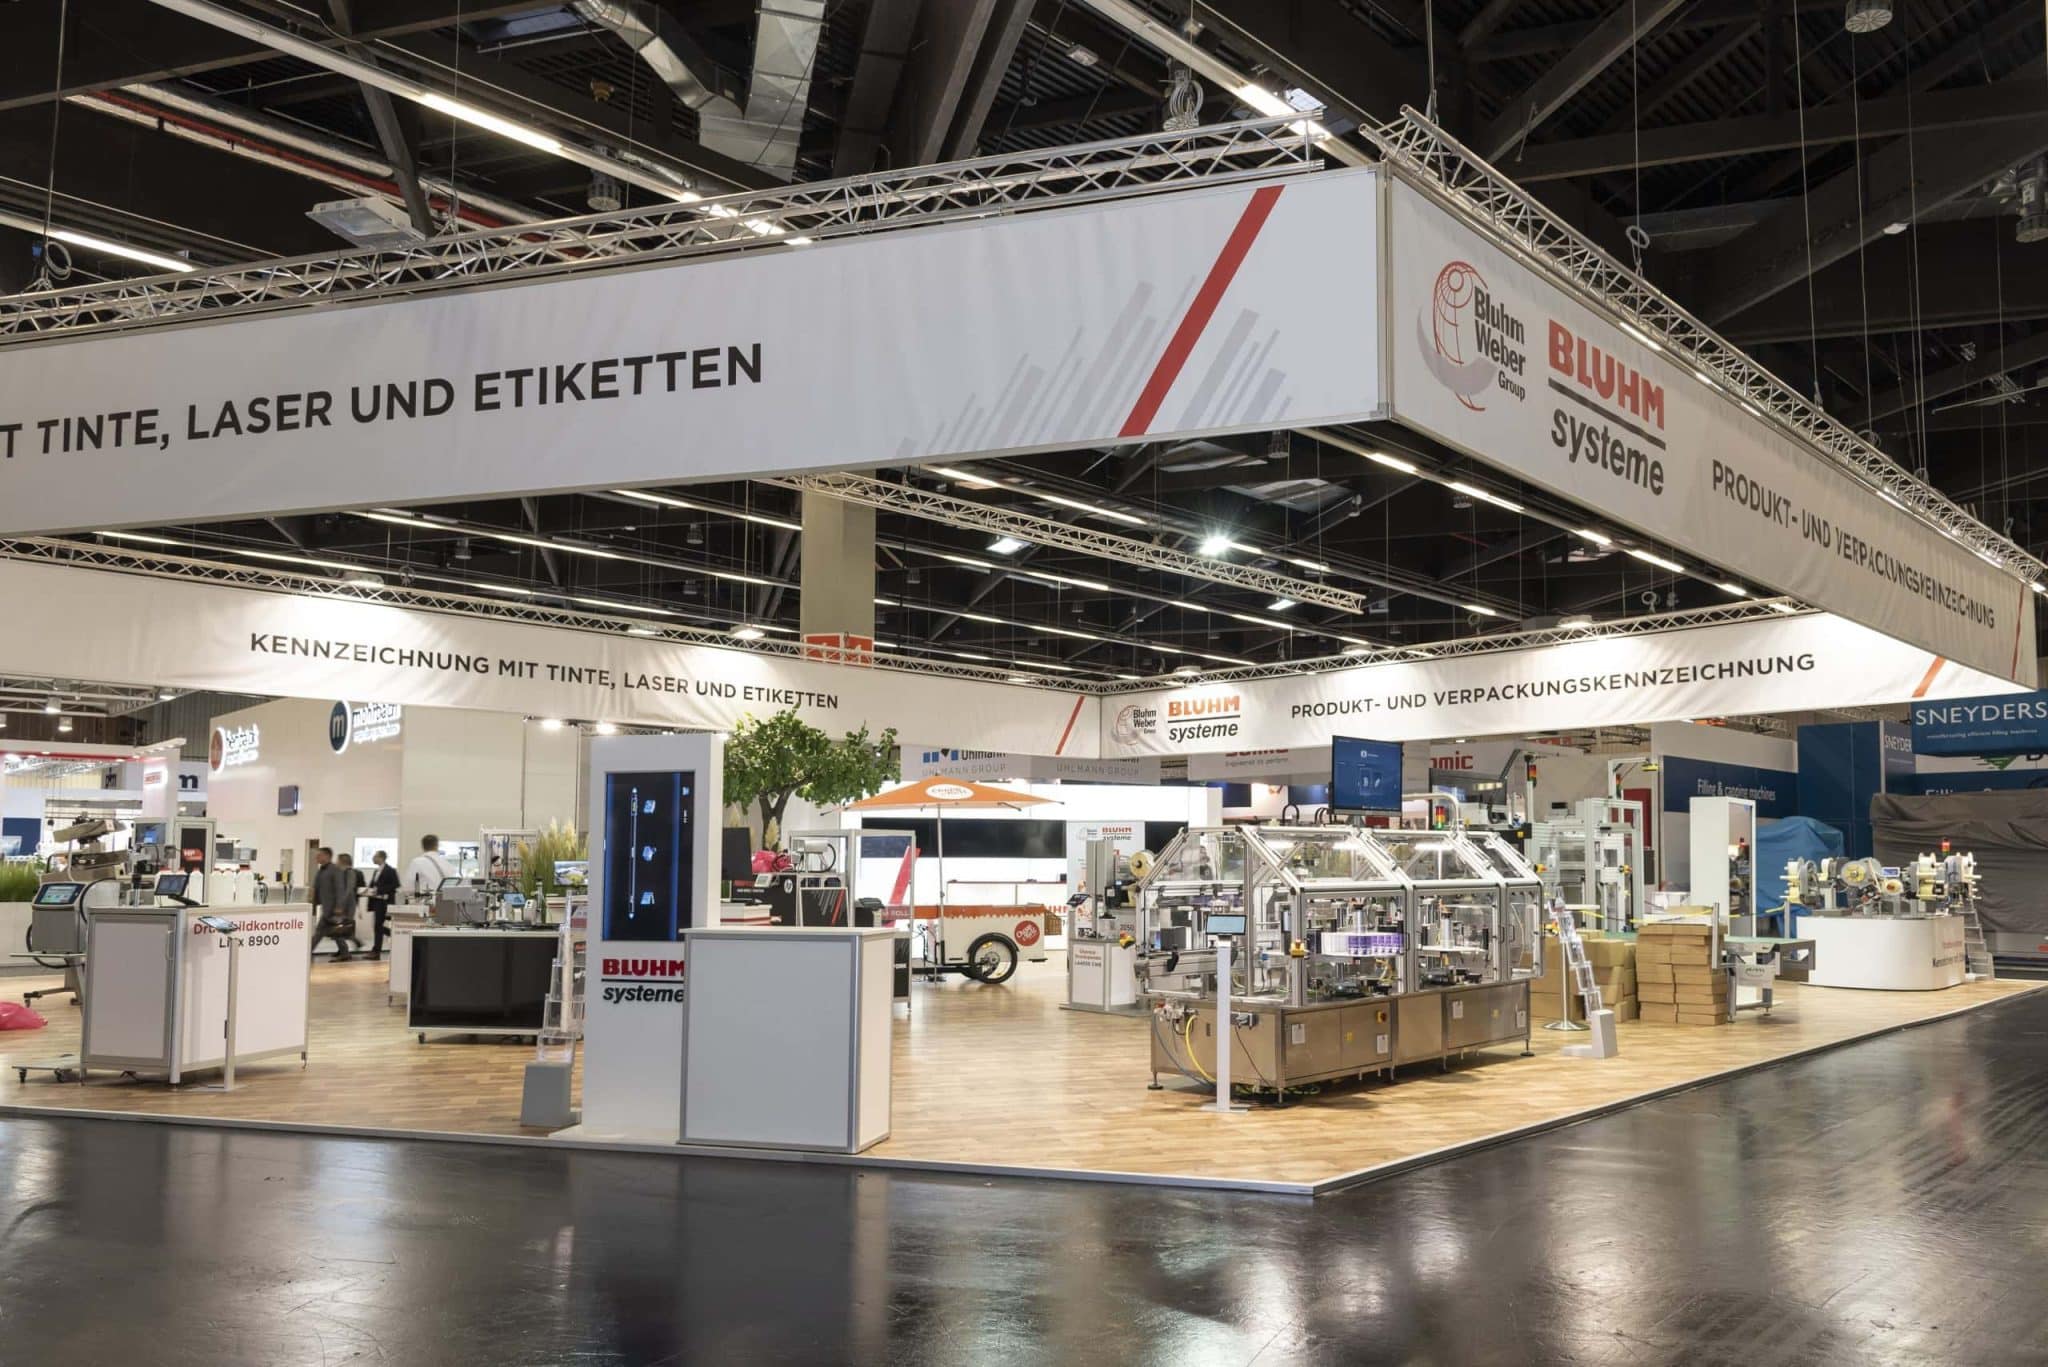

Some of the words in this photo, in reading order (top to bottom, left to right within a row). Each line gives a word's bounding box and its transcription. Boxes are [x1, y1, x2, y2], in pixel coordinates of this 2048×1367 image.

[1474, 286, 1525, 345] Bluhm
[1475, 319, 1526, 376] Weber
[1498, 370, 1526, 402] Group
[1549, 319, 1665, 431] BLUHM
[37, 408, 170, 454] TINTE,
[187, 390, 333, 440] LASER
[351, 378, 455, 424] UND
[474, 343, 762, 412] ETIKETTEN
[1551, 408, 1665, 496] systeme
[1712, 459, 1798, 528] PRODUKT-
[1802, 508, 1831, 548] UND
[250, 633, 490, 674] KENNZEICHNUNG
[498, 659, 538, 679] MIT
[546, 664, 616, 690] TINTE,
[623, 672, 689, 694] LASER
[695, 680, 737, 699] UND
[743, 686, 839, 710] ETIKETTEN
[1291, 698, 1382, 719] PRODUKT-
[1387, 693, 1427, 711] UND
[1433, 653, 1816, 707] VERPACKUNGSKENNZEICHNUNG
[1132, 708, 1158, 720] Bluhm
[1168, 695, 1241, 718] BLUHM
[1915, 702, 2048, 726] SNEYDERS
[1132, 719, 1158, 729] Weber
[1168, 722, 1239, 744] systeme
[219, 937, 244, 948] Lix
[248, 935, 280, 946] 8900
[602, 958, 685, 976] BLUHM
[602, 985, 684, 1004] systeme
